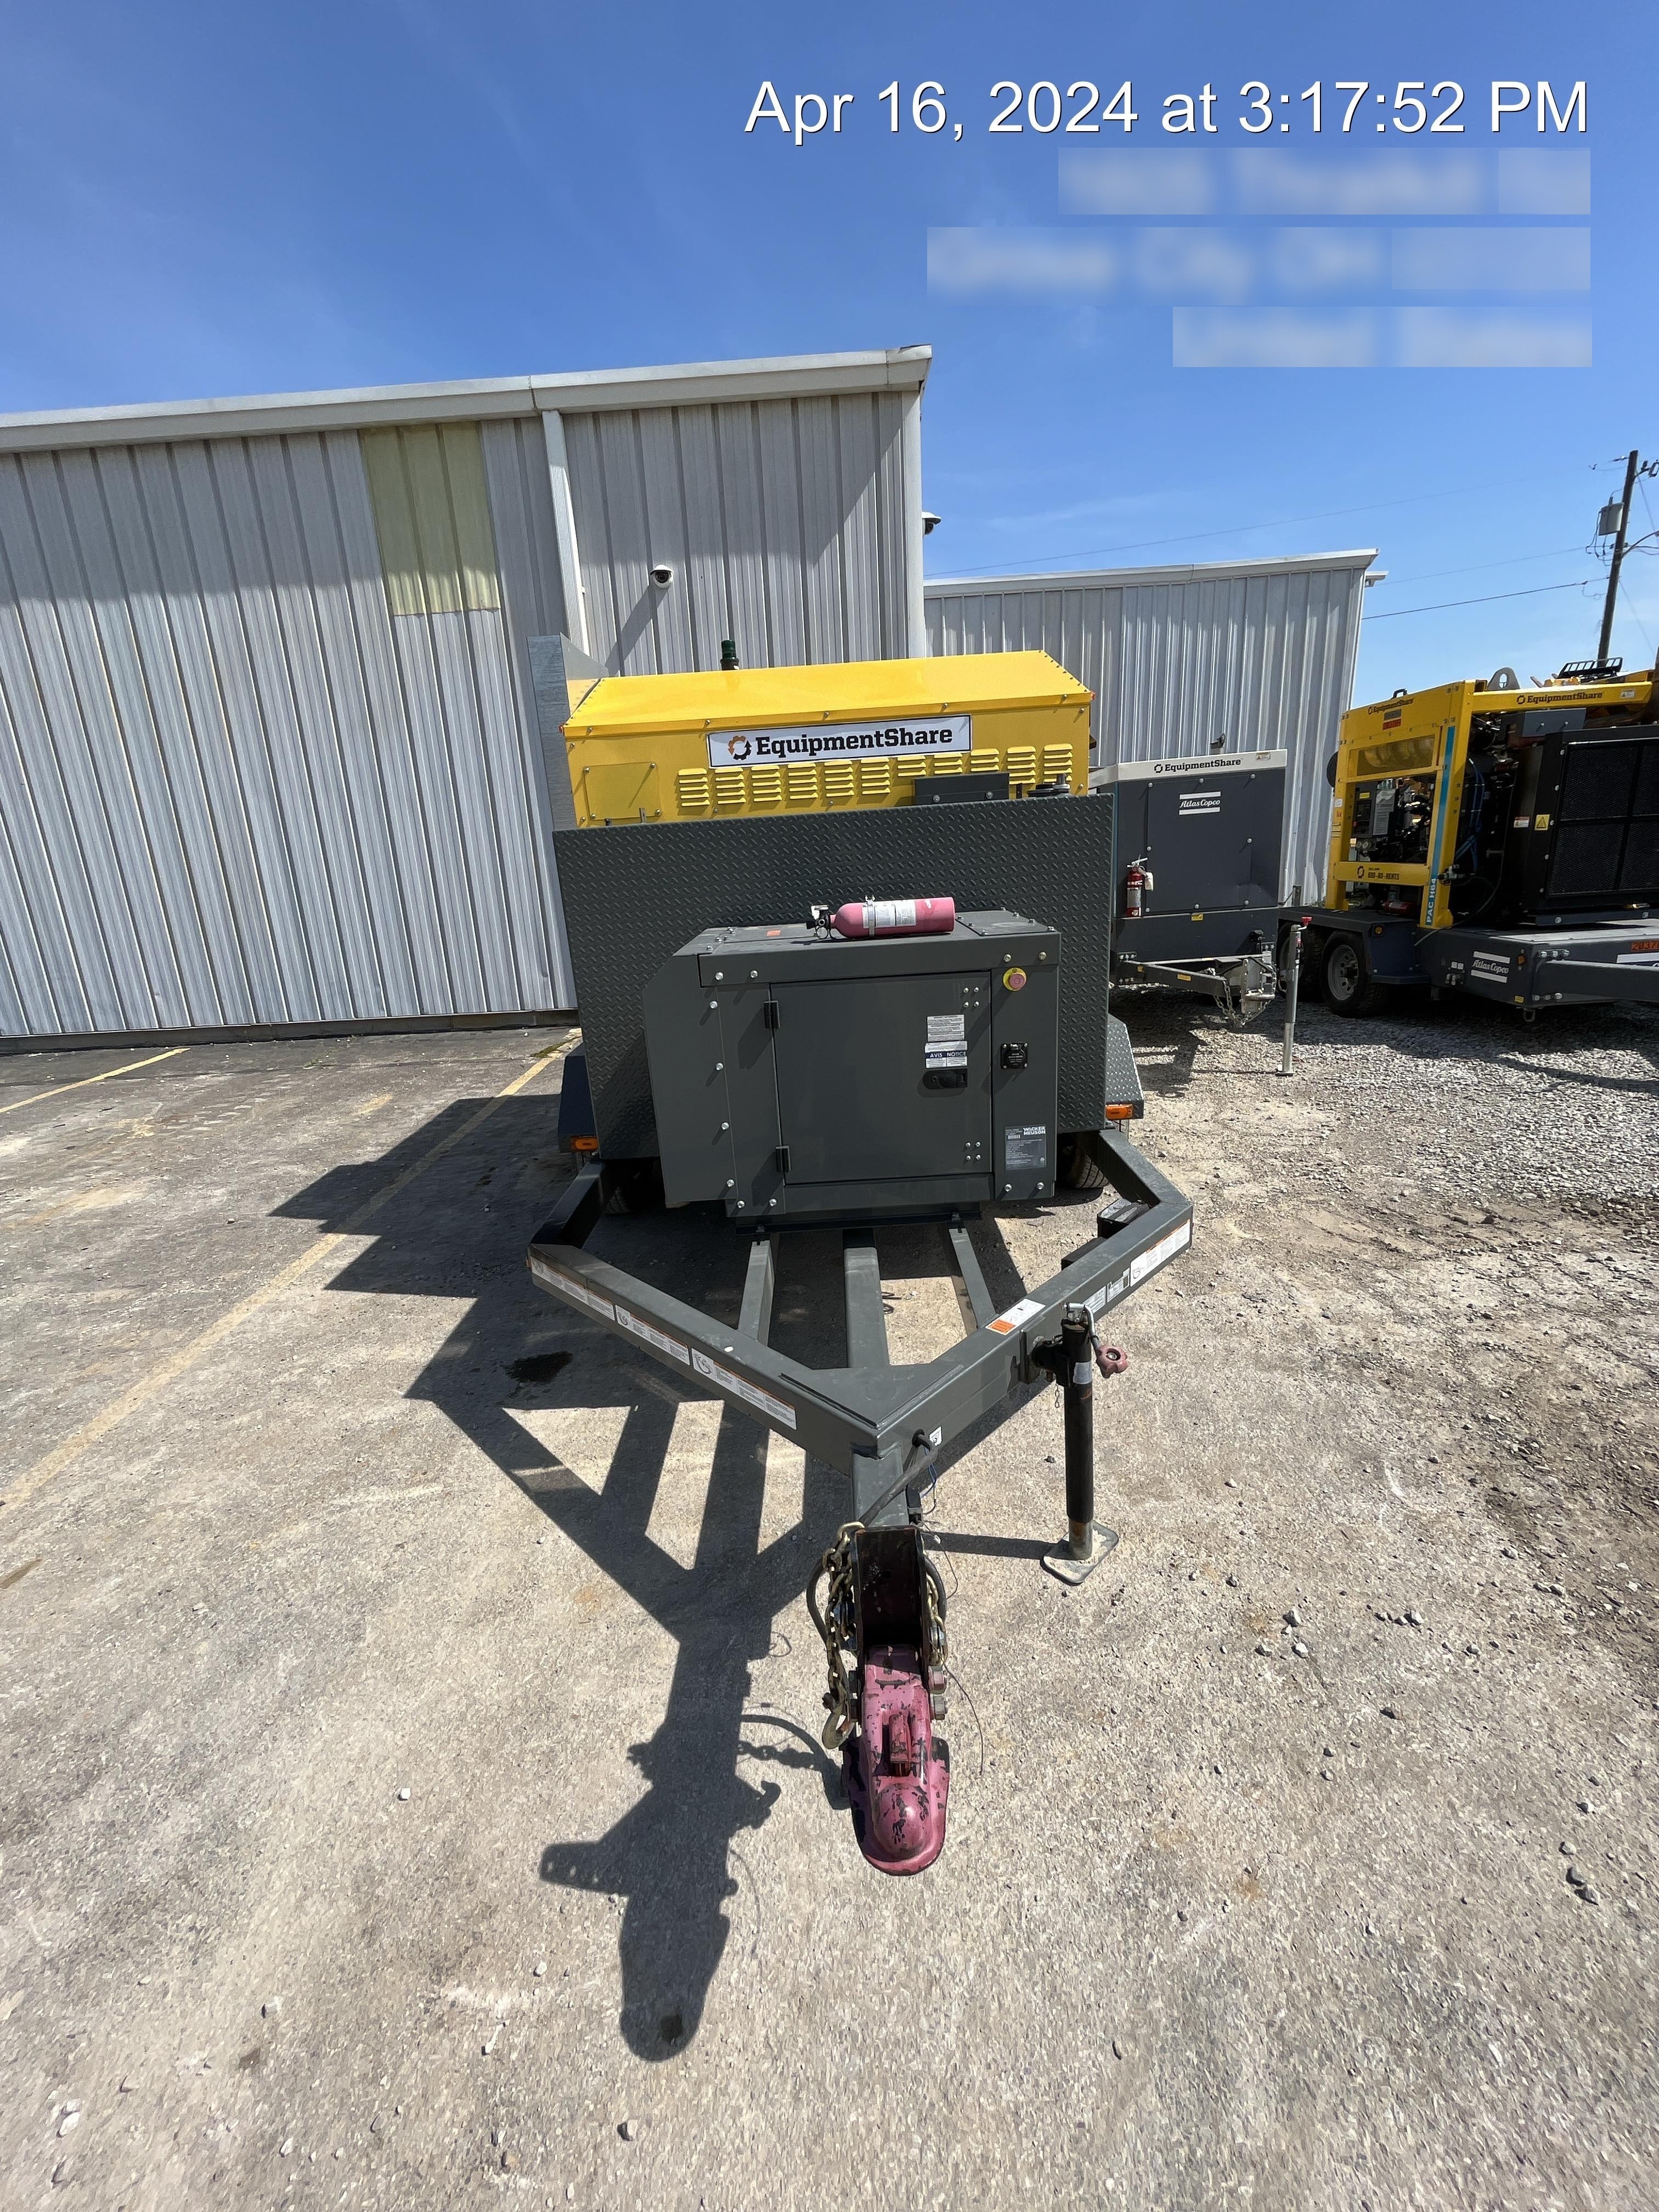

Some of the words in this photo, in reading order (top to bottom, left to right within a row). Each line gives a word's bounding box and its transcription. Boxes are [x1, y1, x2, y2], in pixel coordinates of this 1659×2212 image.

[1527, 692, 1602, 704] EquipmentShare
[755, 727, 953, 758] EquipmentShare
[1165, 759, 1241, 772] EquipmentShare
[1180, 800, 1200, 808] Atlas
[1472, 960, 1491, 970] Atlas
[1490, 962, 1509, 974] Copco
